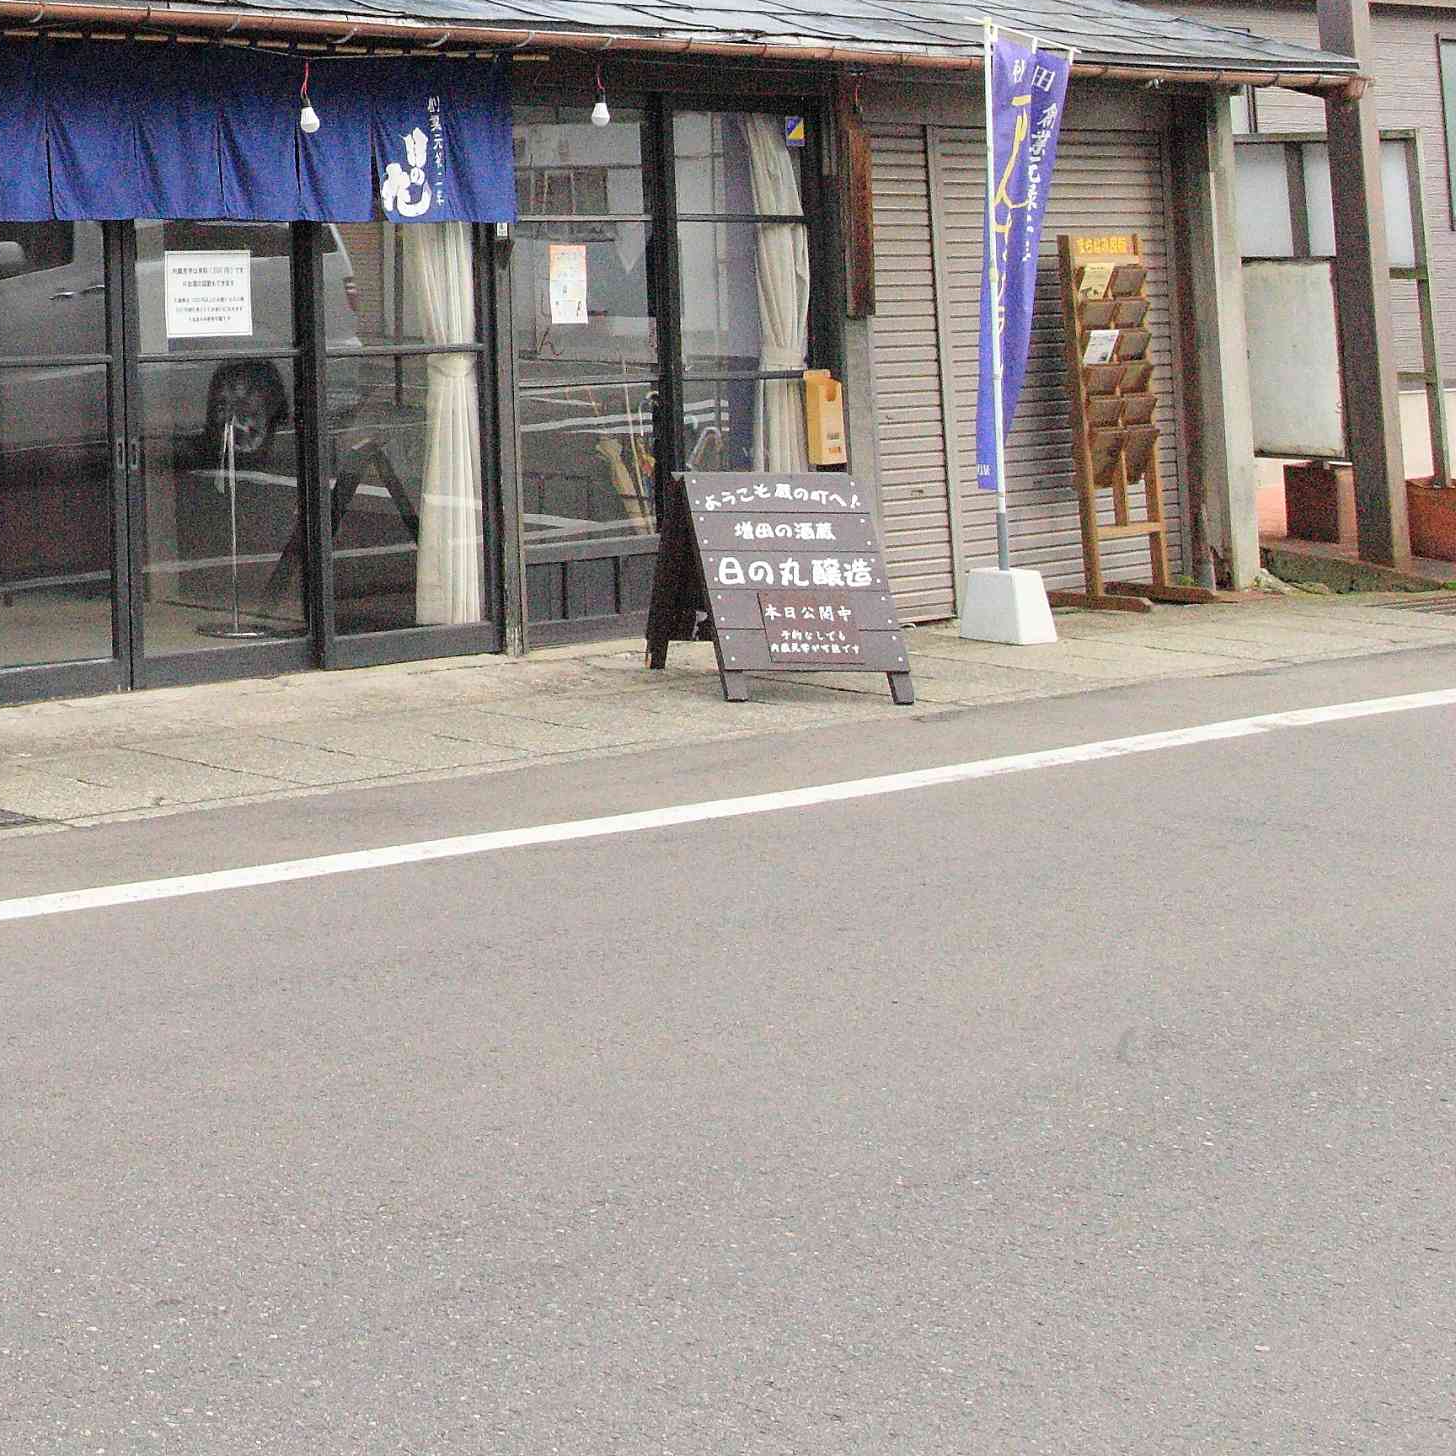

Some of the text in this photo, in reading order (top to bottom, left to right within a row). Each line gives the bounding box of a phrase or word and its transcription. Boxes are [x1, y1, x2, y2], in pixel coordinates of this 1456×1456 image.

[718, 556, 873, 587] 日の丸醸造
